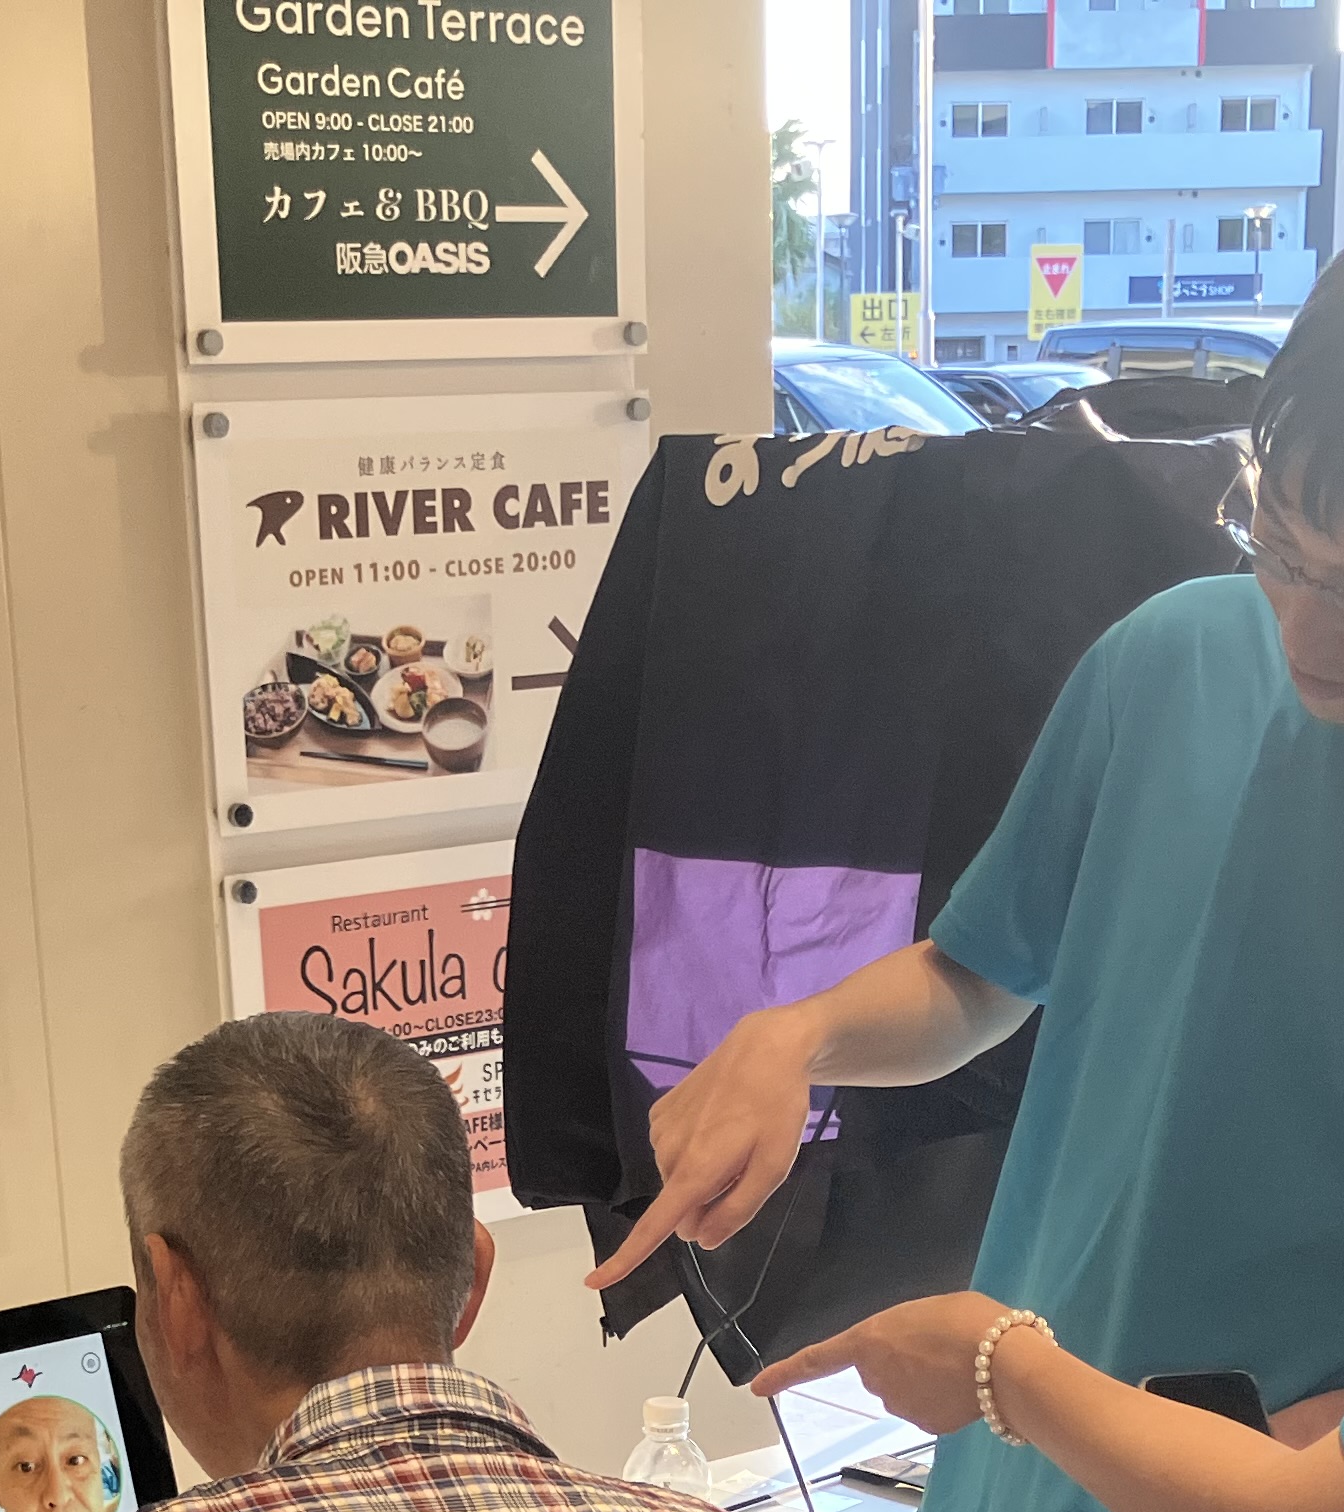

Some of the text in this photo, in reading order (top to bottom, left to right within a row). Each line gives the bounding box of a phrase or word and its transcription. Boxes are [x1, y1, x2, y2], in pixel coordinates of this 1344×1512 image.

[235, 0, 586, 47] Garden Terrace
[257, 62, 466, 101] Garden Café
[261, 111, 311, 130] OPEN
[315, 112, 353, 131] 9:00
[367, 114, 424, 132] CLOSE
[427, 115, 475, 134] 21:00
[263, 142, 356, 162] 売場内カフェ
[262, 185, 490, 231] カフェ & BBQ
[336, 241, 491, 276] 阪急OASIS
[862, 298, 909, 322] 出口
[358, 451, 507, 478] 健康バランス定食
[317, 479, 611, 541] RIVER CAFE
[289, 567, 345, 588] OPEN
[353, 558, 422, 584] 11:00
[444, 556, 505, 578] CLOSE
[511, 548, 577, 574] 20:00
[331, 903, 430, 934] Restaurant
[300, 928, 467, 1016] Sakula
[482, 1061, 504, 1082] SP
[472, 1086, 503, 1104] キセラ
